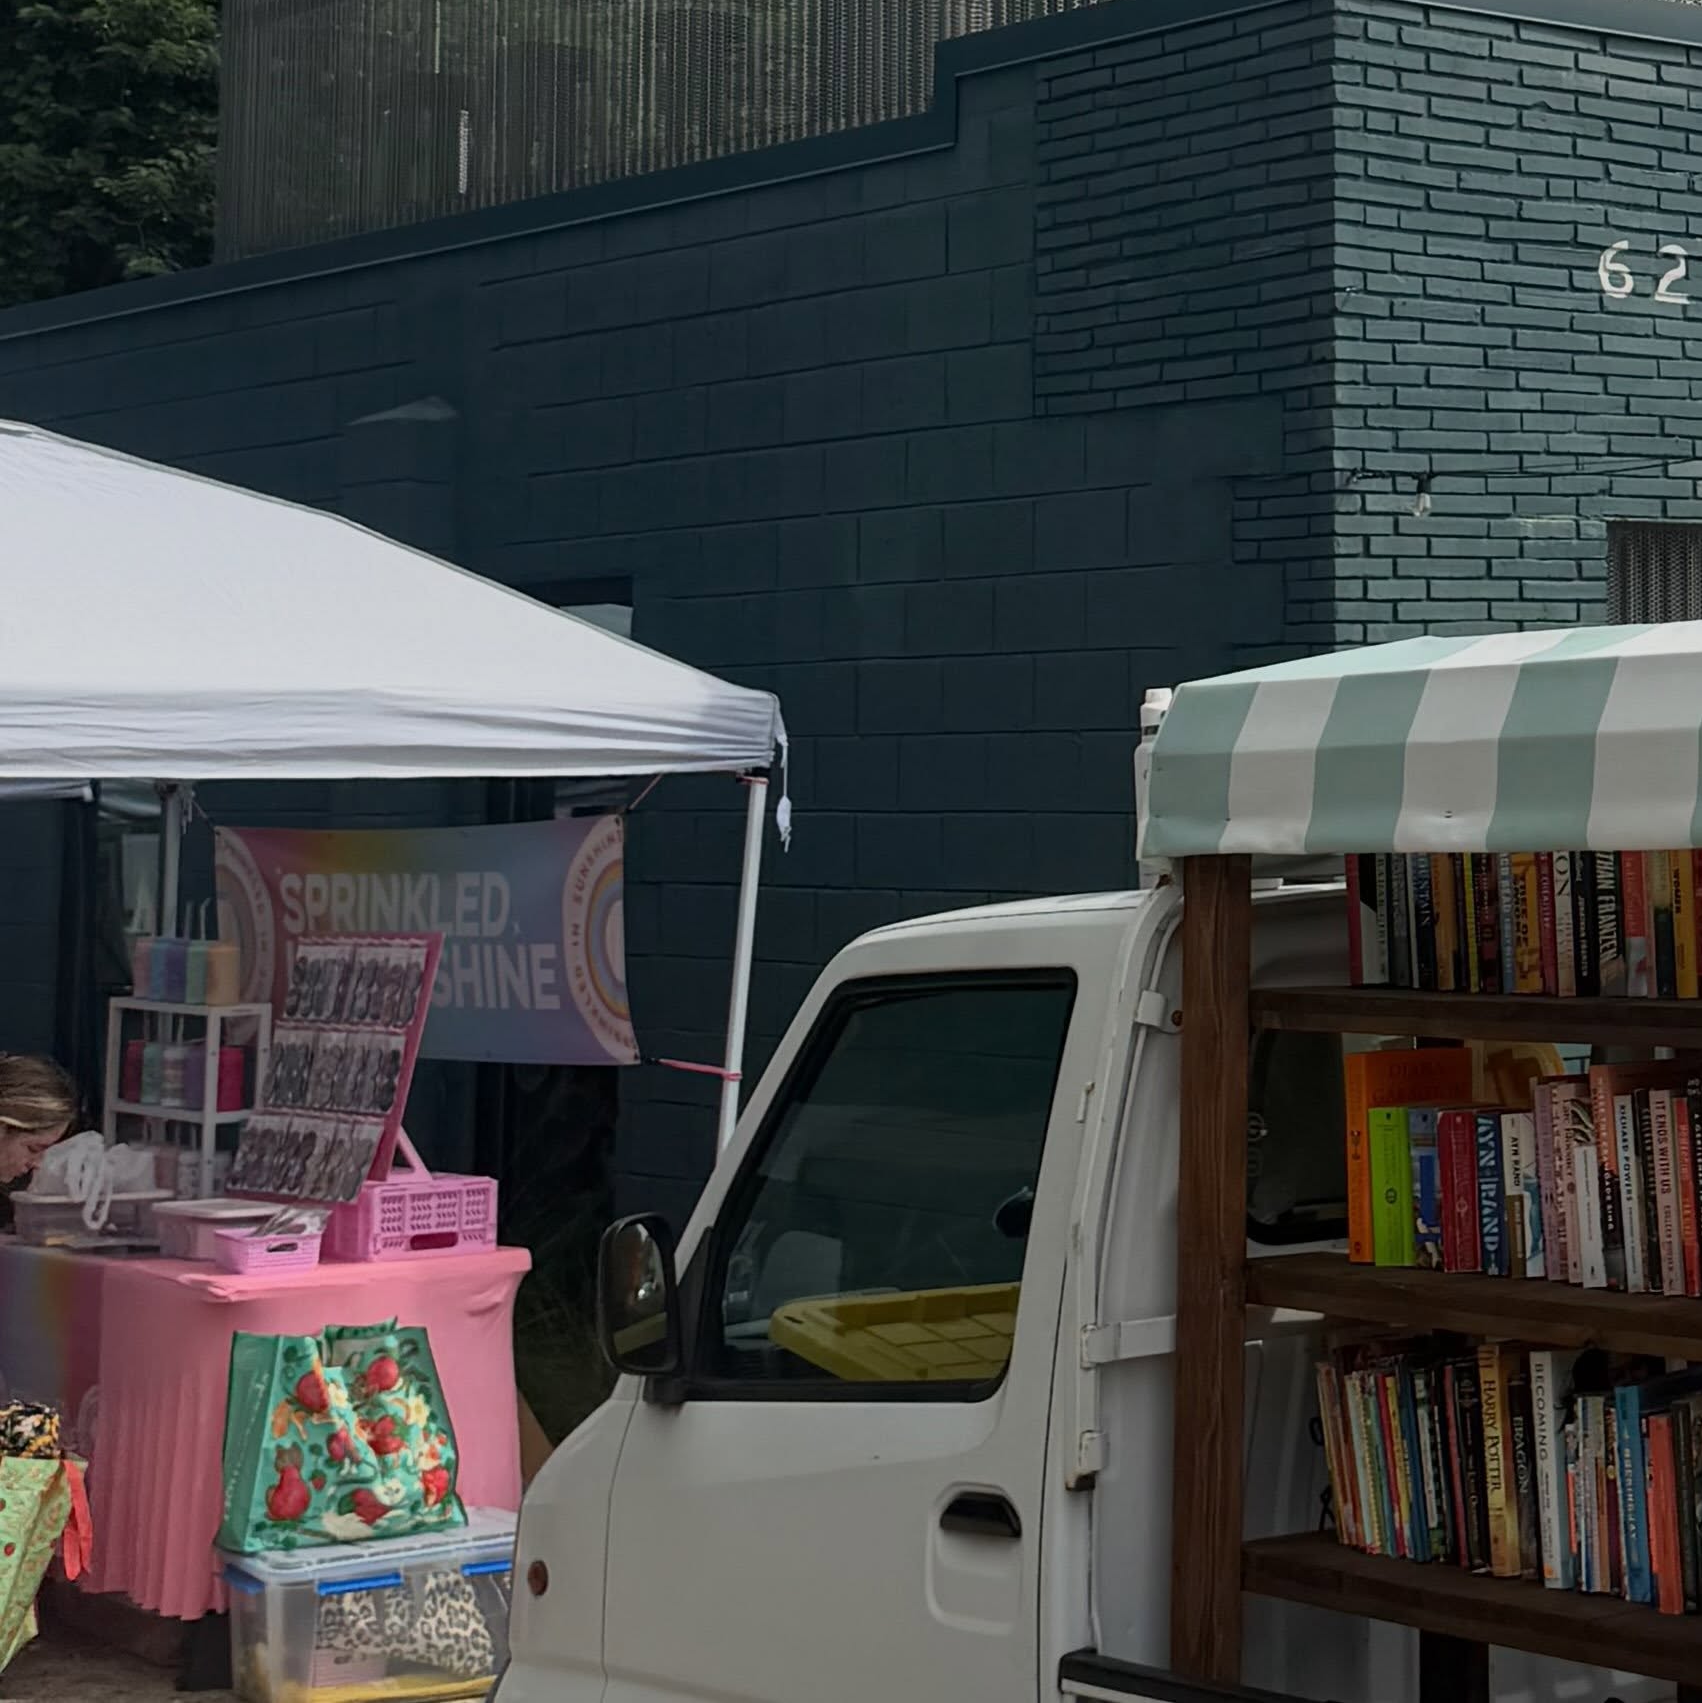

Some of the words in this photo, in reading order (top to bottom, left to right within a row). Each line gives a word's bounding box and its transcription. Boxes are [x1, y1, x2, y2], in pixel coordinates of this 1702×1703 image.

[1595, 852, 1616, 890] THAN
[280, 871, 510, 937] SPRINKLED
[1596, 894, 1619, 963] FRANZEN
[434, 943, 560, 1009] SHINE
[1618, 1104, 1629, 1152] RICHARD
[1655, 1101, 1666, 1111] IT
[1655, 1114, 1668, 1144] ENDS
[1477, 1117, 1496, 1168] AYN
[1511, 1136, 1519, 1156] AYN
[1658, 1147, 1670, 1176] WITH
[1512, 1160, 1521, 1187] RAND
[1622, 1156, 1633, 1202] POWERS
[1660, 1179, 1671, 1194] US
[1480, 1183, 1500, 1252] RAND
[1484, 1379, 1498, 1429] HARRY
[1533, 1363, 1549, 1461] BECOMING
[1487, 1434, 1504, 1493] POTTER
[1513, 1415, 1529, 1494] ERAGON
